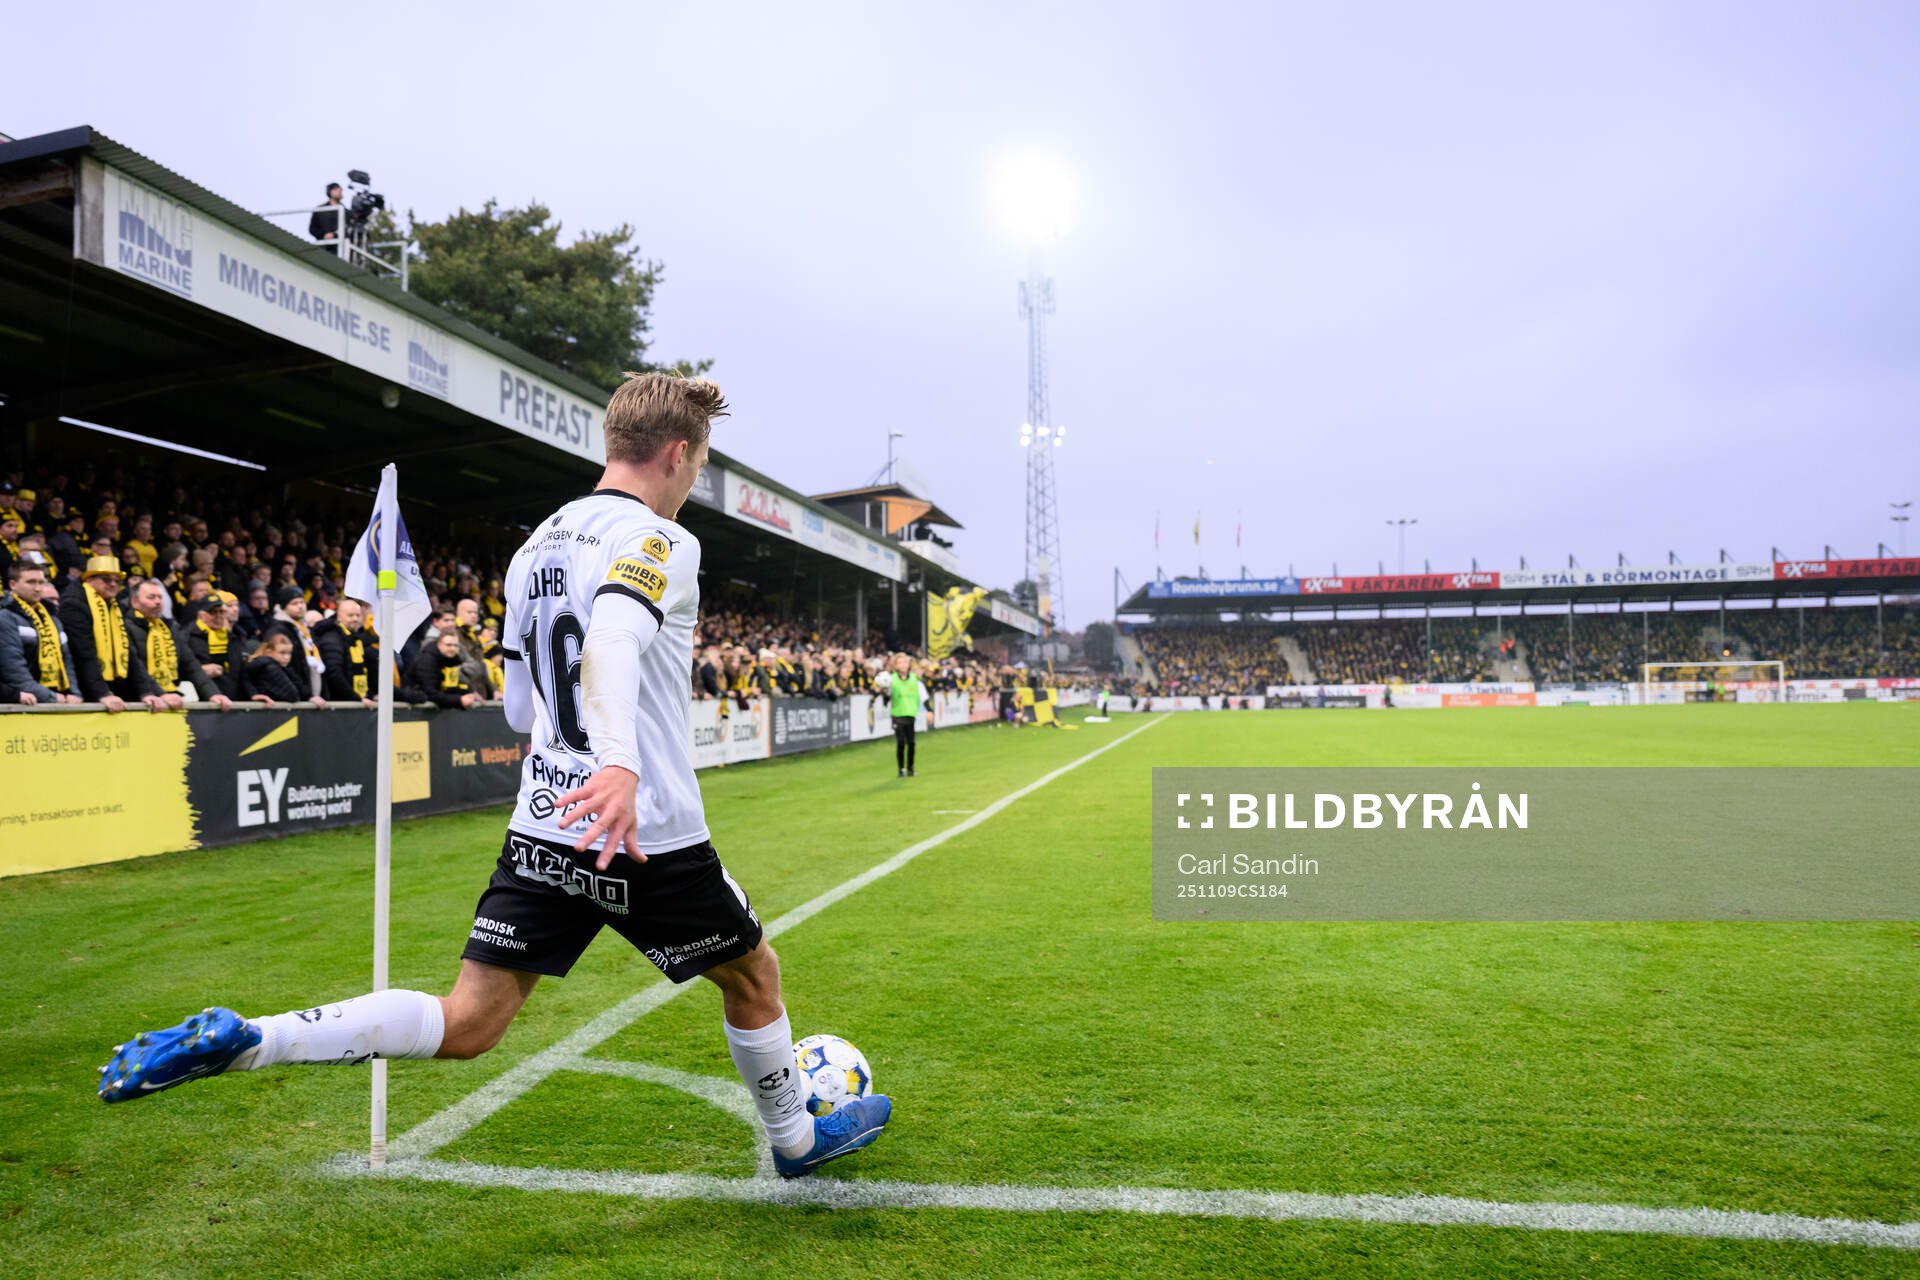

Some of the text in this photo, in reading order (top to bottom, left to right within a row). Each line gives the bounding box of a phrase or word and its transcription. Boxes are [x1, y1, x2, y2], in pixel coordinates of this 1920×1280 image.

[119, 242, 192, 291] MARINE
[219, 253, 391, 352] MMGMARINE.SE
[501, 370, 592, 449] PREFAST
[615, 563, 664, 591] UNIBET
[1541, 572, 1576, 585] STÅL
[1585, 574, 1596, 583] &
[1602, 568, 1728, 583] RÖRMONTAGE
[1837, 561, 1920, 577] LÄKTAR
[520, 611, 594, 755] 16
[5, 731, 131, 757] att vägleda dig till
[451, 747, 477, 767] Print
[237, 767, 289, 828] EY
[287, 782, 363, 804] Building a better
[31, 808, 85, 823] transaktioner
[287, 798, 353, 821] working world
[664, 933, 722, 956] NORDISK
[670, 934, 740, 965] GRUNDTEKNIK
